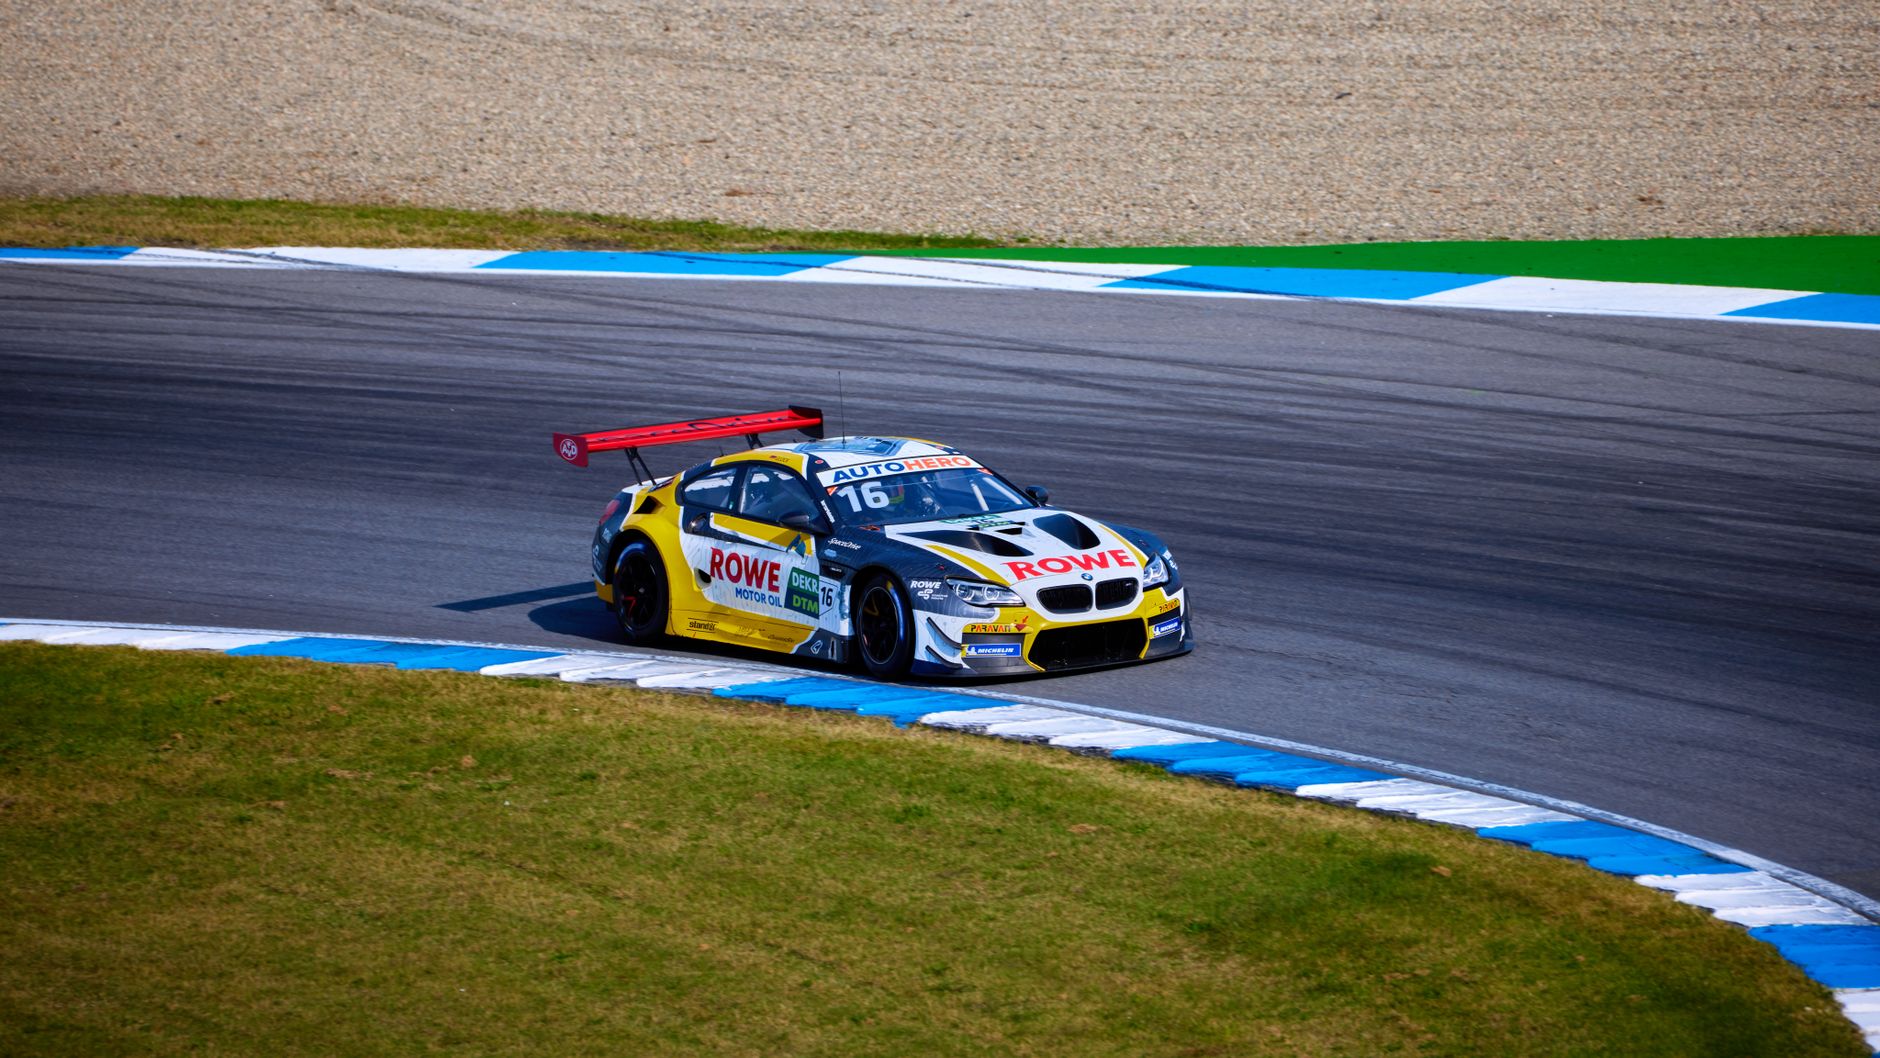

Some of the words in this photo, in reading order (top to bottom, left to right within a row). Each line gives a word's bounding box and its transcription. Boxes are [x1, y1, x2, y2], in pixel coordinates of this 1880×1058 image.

[833, 456, 971, 483] AUTOHERO
[837, 481, 890, 513] 16
[710, 547, 782, 593] ROWE
[1002, 549, 1136, 581] ROWE
[792, 571, 819, 593] DEKR
[910, 580, 942, 589] ROWE
[735, 587, 767, 604] MOTOR
[767, 595, 783, 608] OIL
[793, 595, 819, 614] DTM
[821, 586, 833, 607] 16
[971, 624, 1011, 632] PARAVAN
